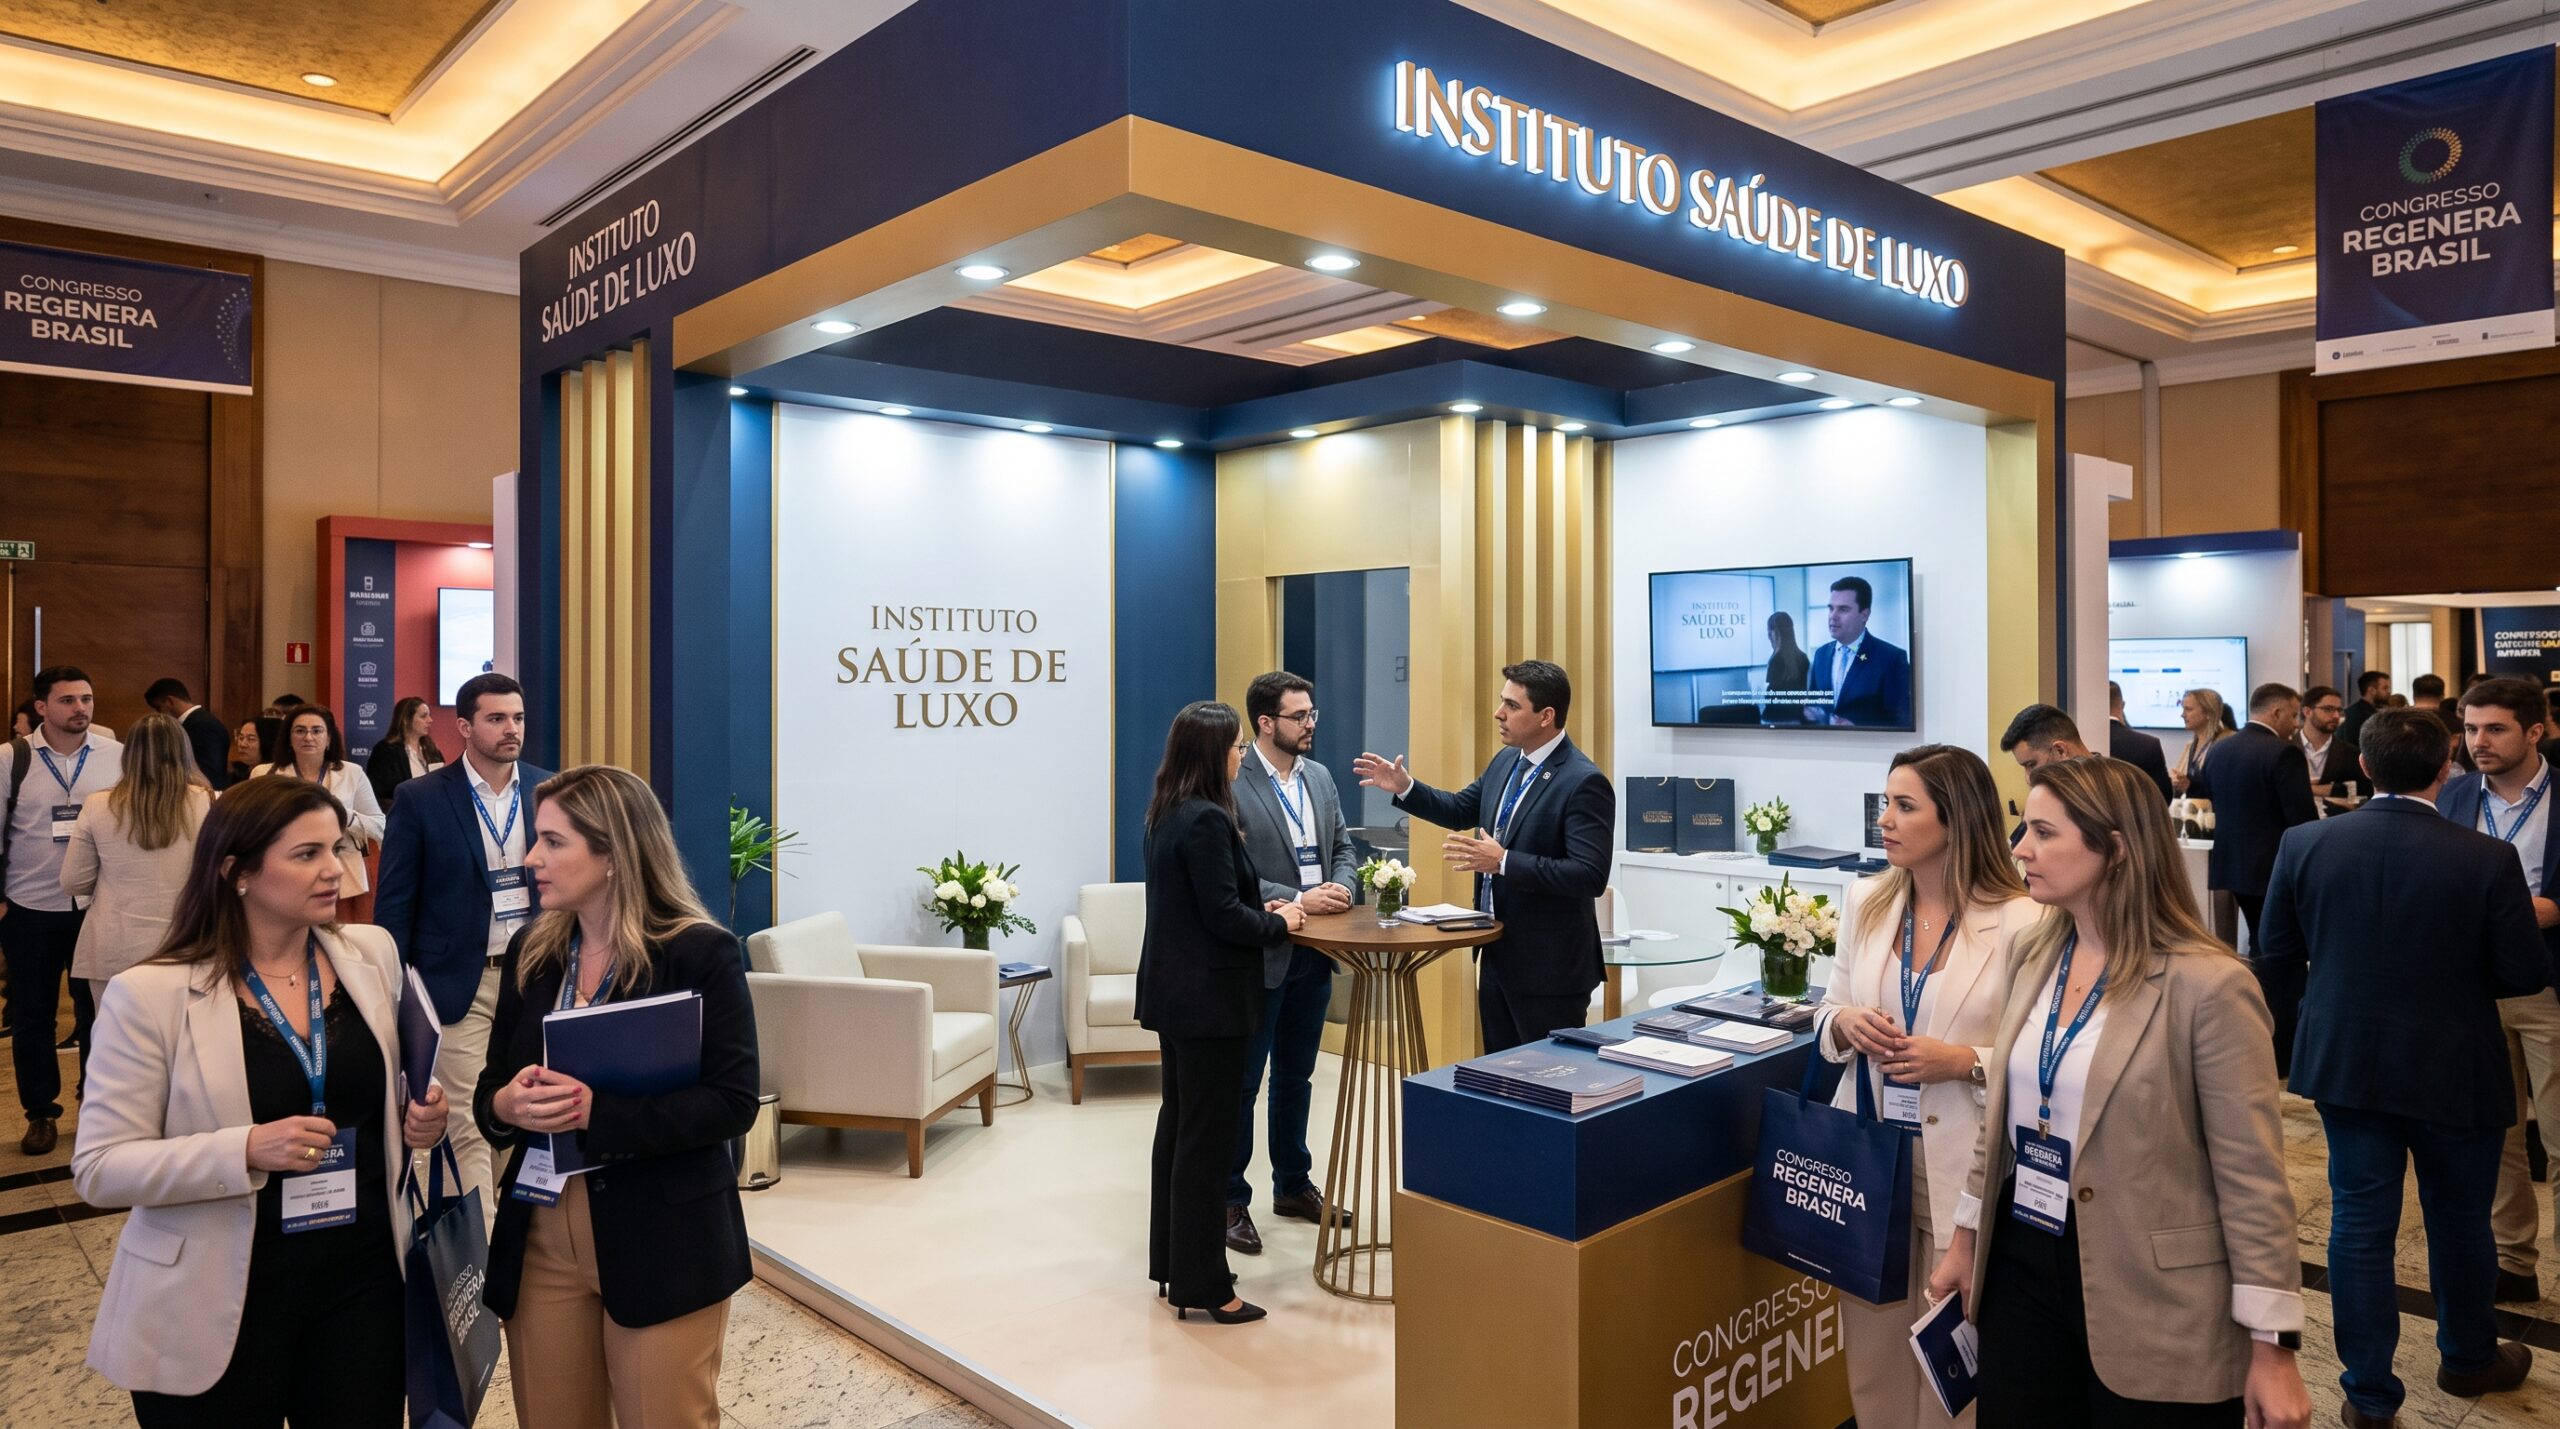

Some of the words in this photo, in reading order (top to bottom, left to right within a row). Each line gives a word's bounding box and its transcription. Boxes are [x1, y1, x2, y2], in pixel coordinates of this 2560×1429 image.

[1395, 60, 1682, 216] INSTITUTO
[1688, 168, 1822, 263] SAÚDE
[1826, 216, 1877, 281] DE
[1880, 235, 1970, 308] LUXO
[2360, 182, 2500, 222] CONGRESSO
[569, 199, 660, 280] INSTITUTO
[2343, 201, 2522, 254] REGENERA
[2371, 237, 2491, 278] BRASIL
[20, 274, 143, 303] CONGRESSO
[541, 280, 599, 343] SAÚDE
[604, 263, 630, 314] DE
[636, 231, 697, 299] LUXO
[4, 290, 158, 329] REGENERA
[31, 318, 134, 349] BRASIL
[871, 605, 1038, 634] INSTITUTO
[1681, 610, 1726, 626] SAÚDE
[1730, 613, 1747, 625] DE
[1692, 601, 1739, 610] INSTITUTO
[1699, 627, 1735, 639] LUXO
[837, 637, 994, 684] SAÚDE
[1010, 648, 1067, 683] DE
[893, 692, 1018, 729] LUXO
[1776, 1149, 1852, 1184] CONGRESSO
[1772, 1162, 1866, 1212] REGENERA
[1785, 1186, 1846, 1226] BRASIL
[1673, 1276, 1832, 1378] CONGRESSO
